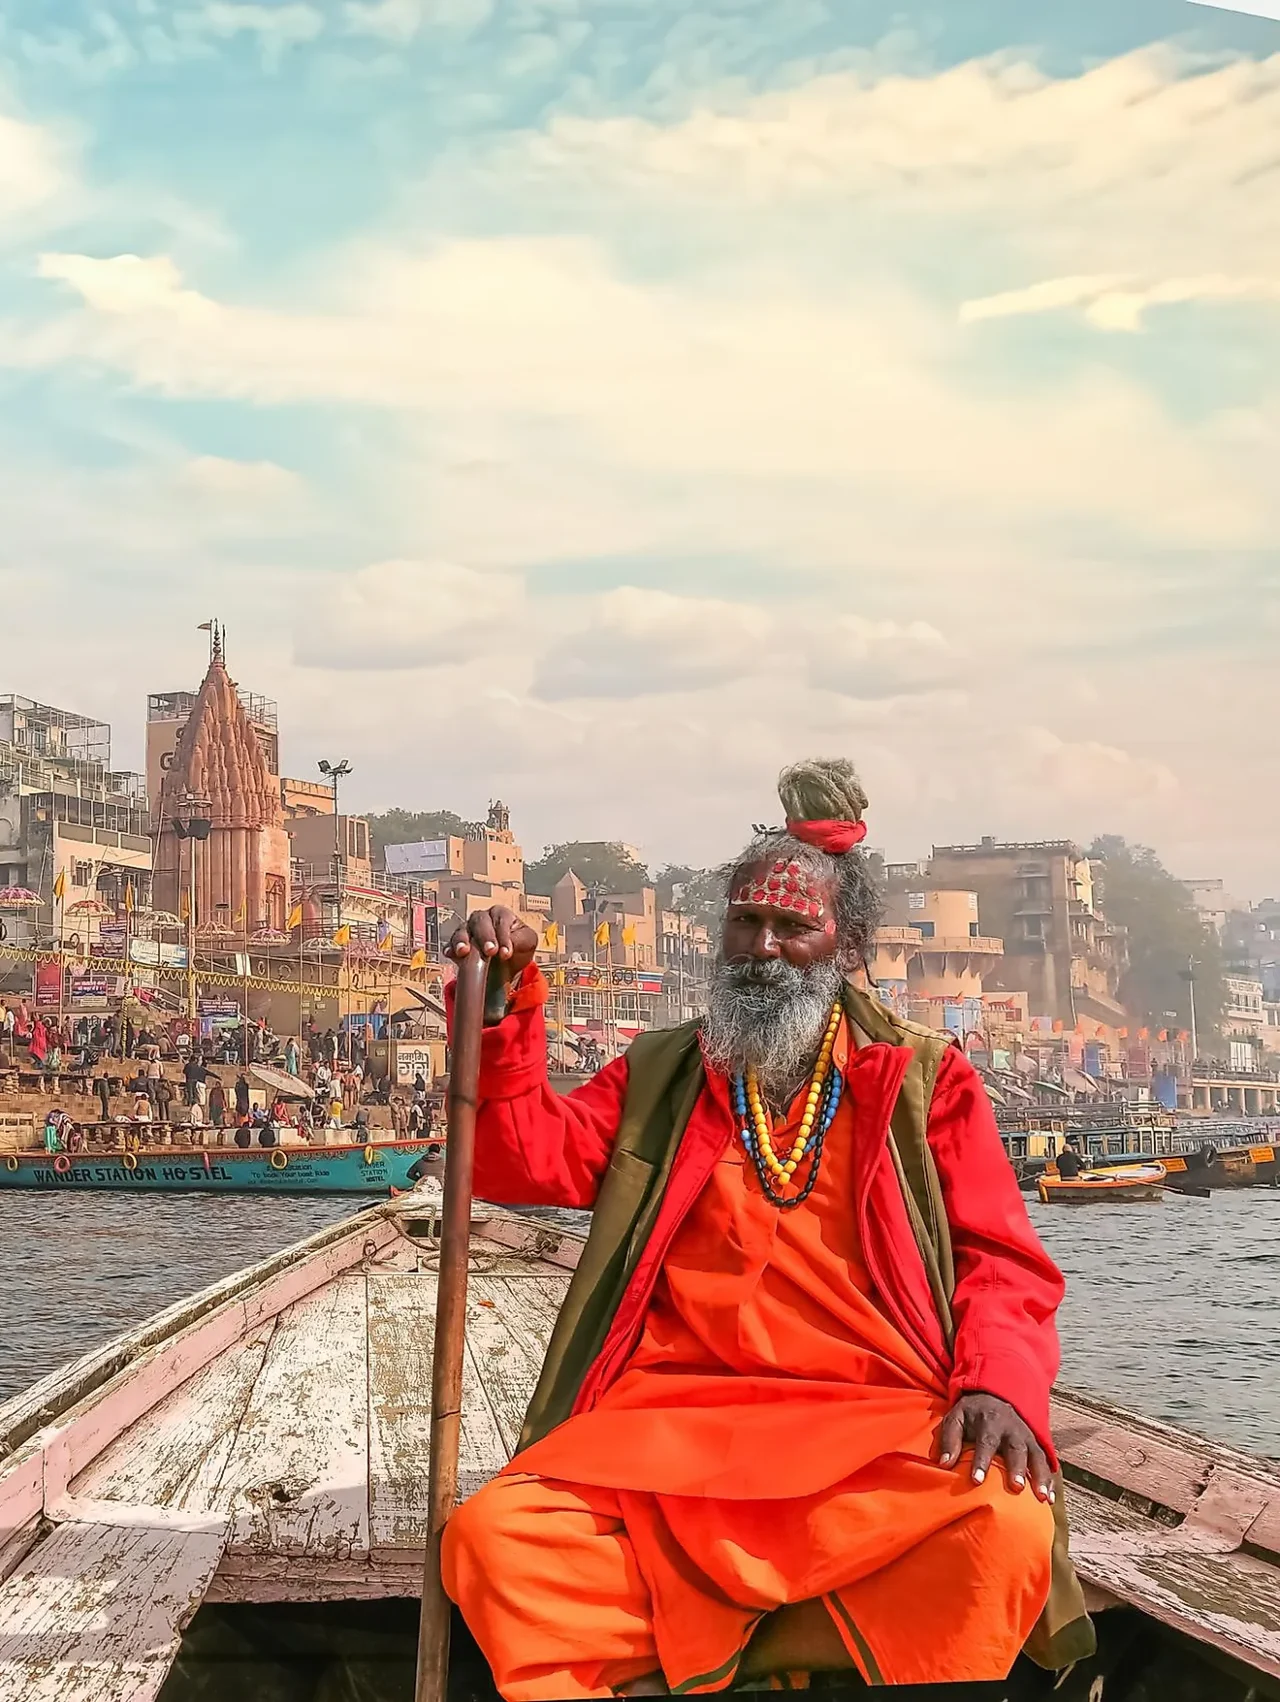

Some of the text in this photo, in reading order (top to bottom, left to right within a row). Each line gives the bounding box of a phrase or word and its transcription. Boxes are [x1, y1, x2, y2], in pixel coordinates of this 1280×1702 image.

[33, 1166, 233, 1183] WANDER STATION HOSTEL
[360, 1169, 388, 1177] STATION
